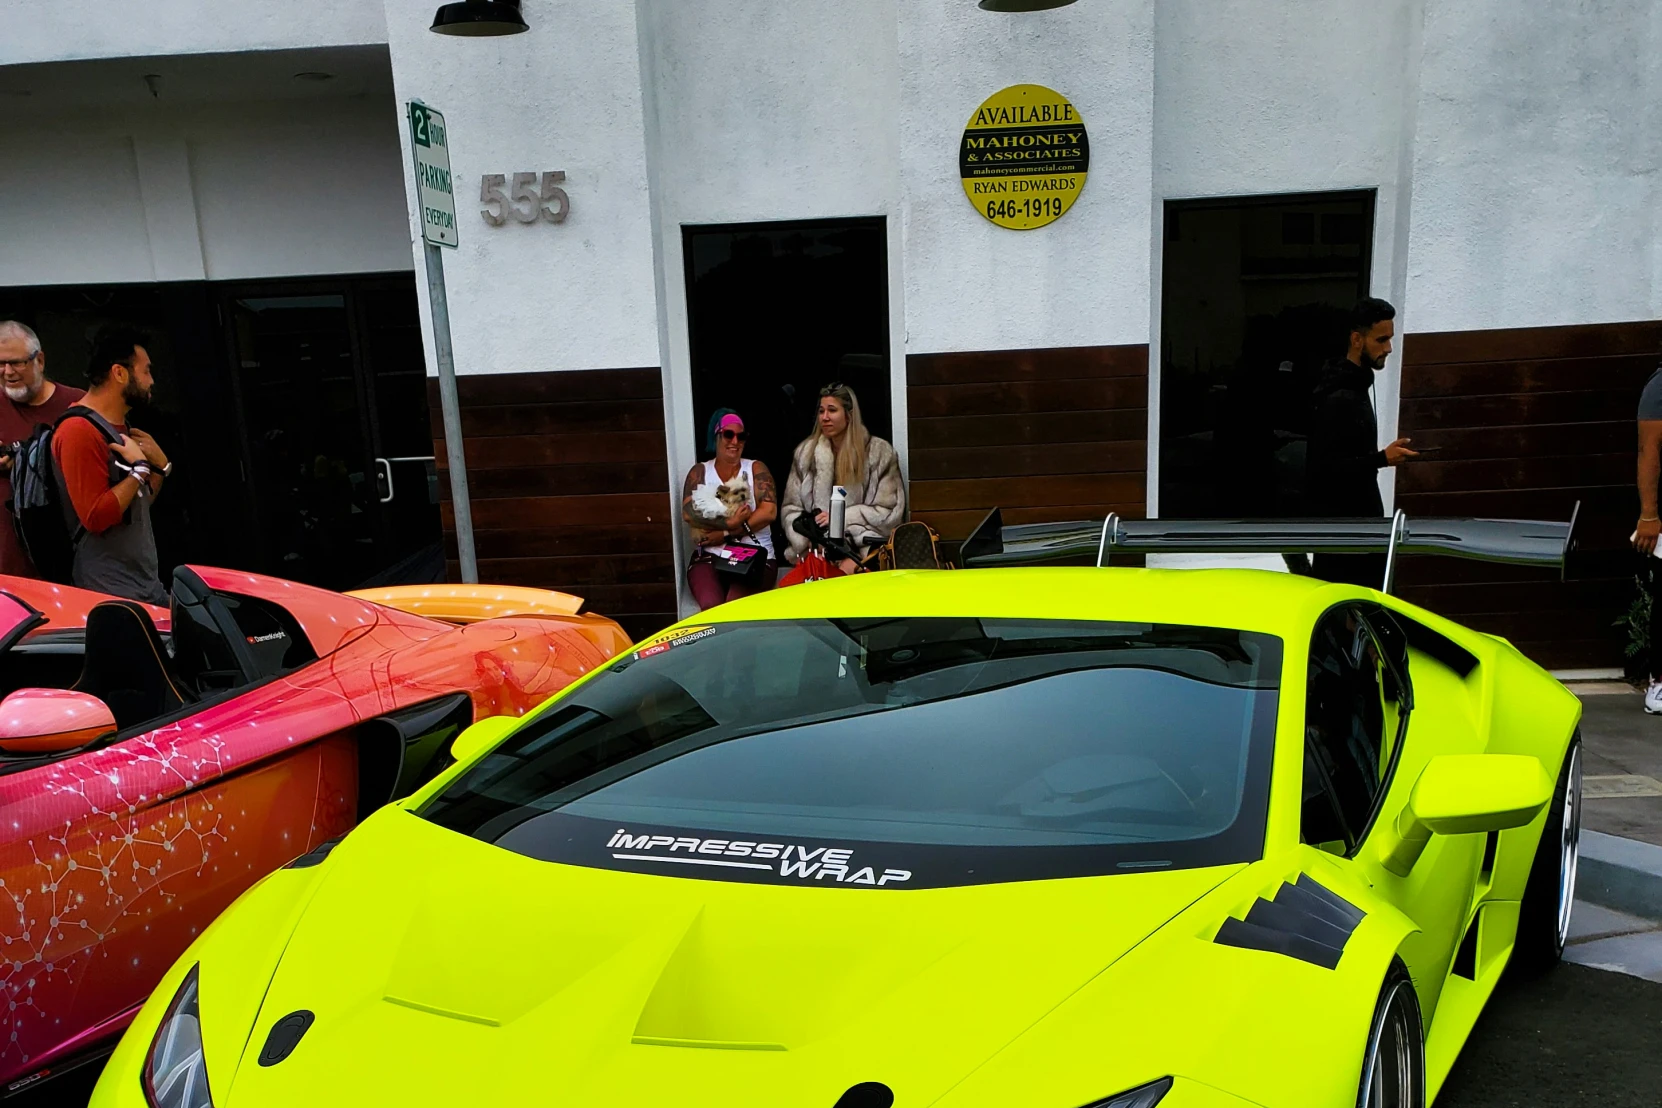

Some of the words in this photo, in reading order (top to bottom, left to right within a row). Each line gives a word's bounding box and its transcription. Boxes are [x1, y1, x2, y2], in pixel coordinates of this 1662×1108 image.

[975, 103, 1073, 126] AVAILABLE
[415, 109, 426, 141] 2
[430, 122, 445, 148] HOUR
[966, 132, 1083, 149] MAHONEY
[967, 153, 979, 162] &
[983, 148, 1081, 161] ASSOCIATES
[419, 161, 452, 195] PARKING
[973, 164, 1075, 176] mahoneycommercial.com
[973, 181, 1007, 194] RYAN
[1012, 178, 1076, 193] EDWARDS
[480, 170, 570, 226] 555
[986, 197, 1062, 219] 646-1919
[425, 207, 453, 230] EVERYDAY
[779, 859, 912, 886] WRAP
